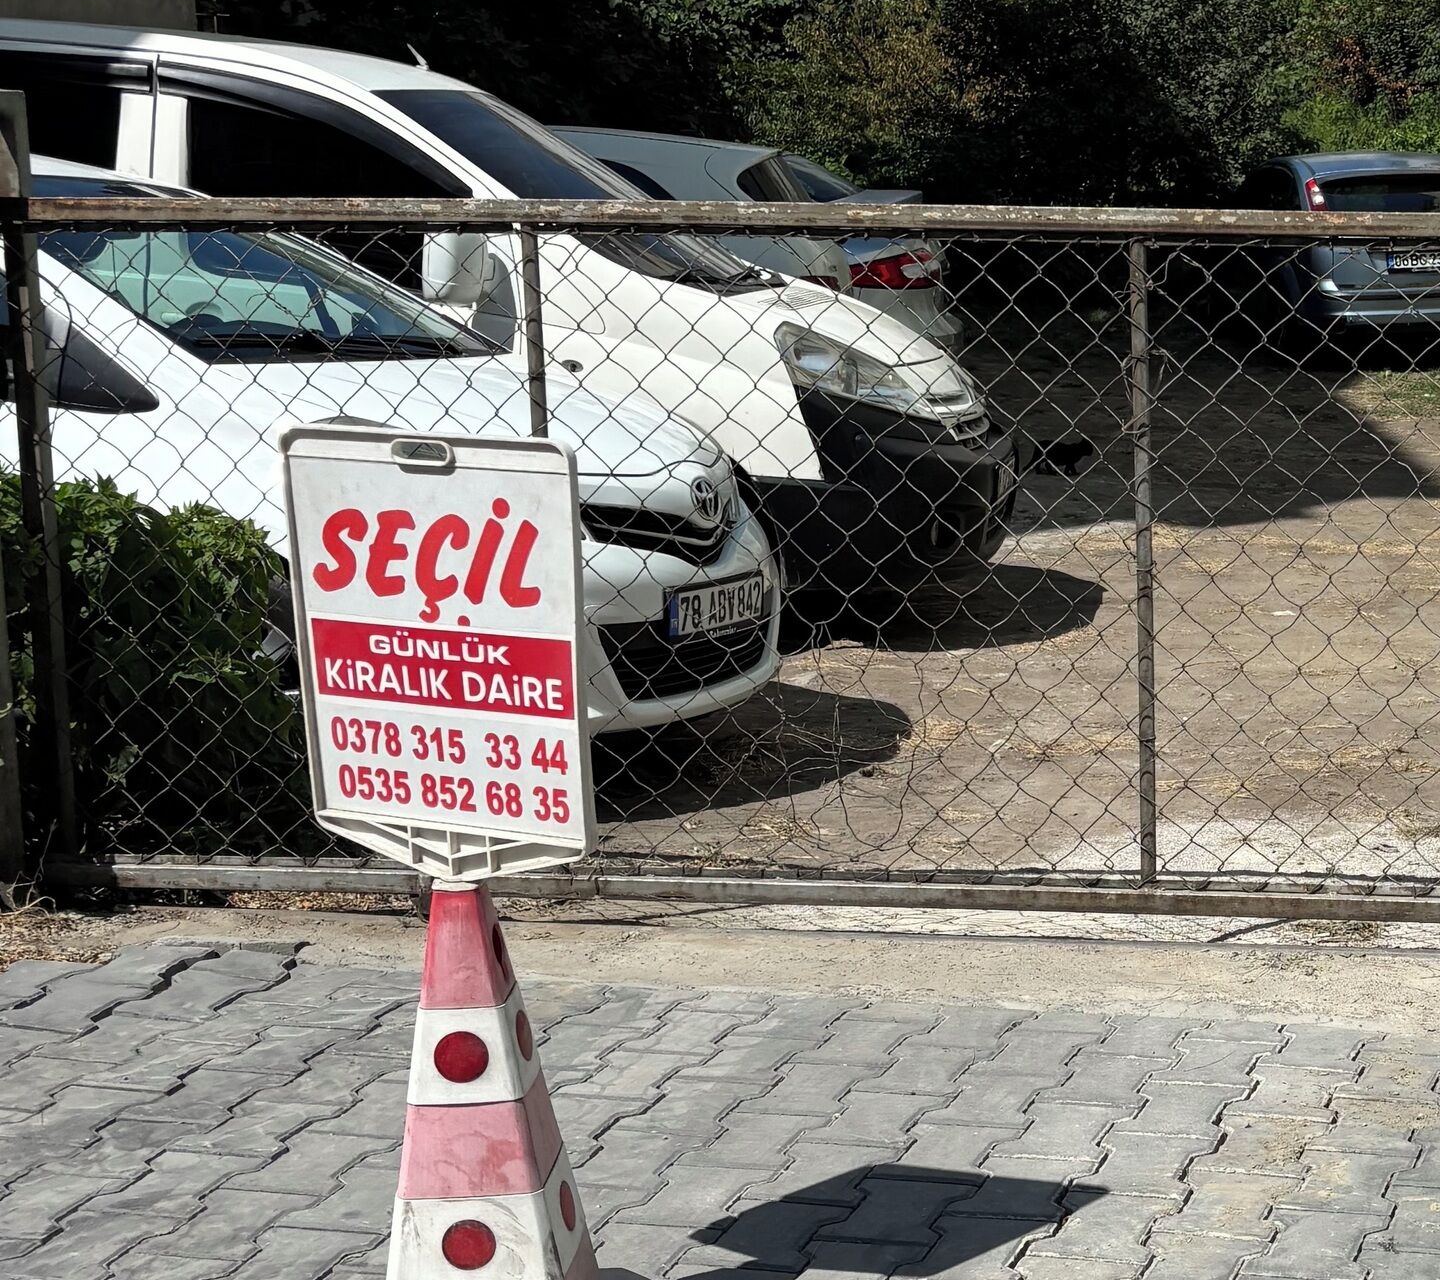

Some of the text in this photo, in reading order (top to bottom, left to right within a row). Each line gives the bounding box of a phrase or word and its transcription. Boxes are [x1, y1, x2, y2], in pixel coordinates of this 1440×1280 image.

[369, 629, 511, 666] GÜNLÜK
[331, 716, 568, 775] 0378 315 33 44
[338, 764, 570, 824] 0535 852 68 35
